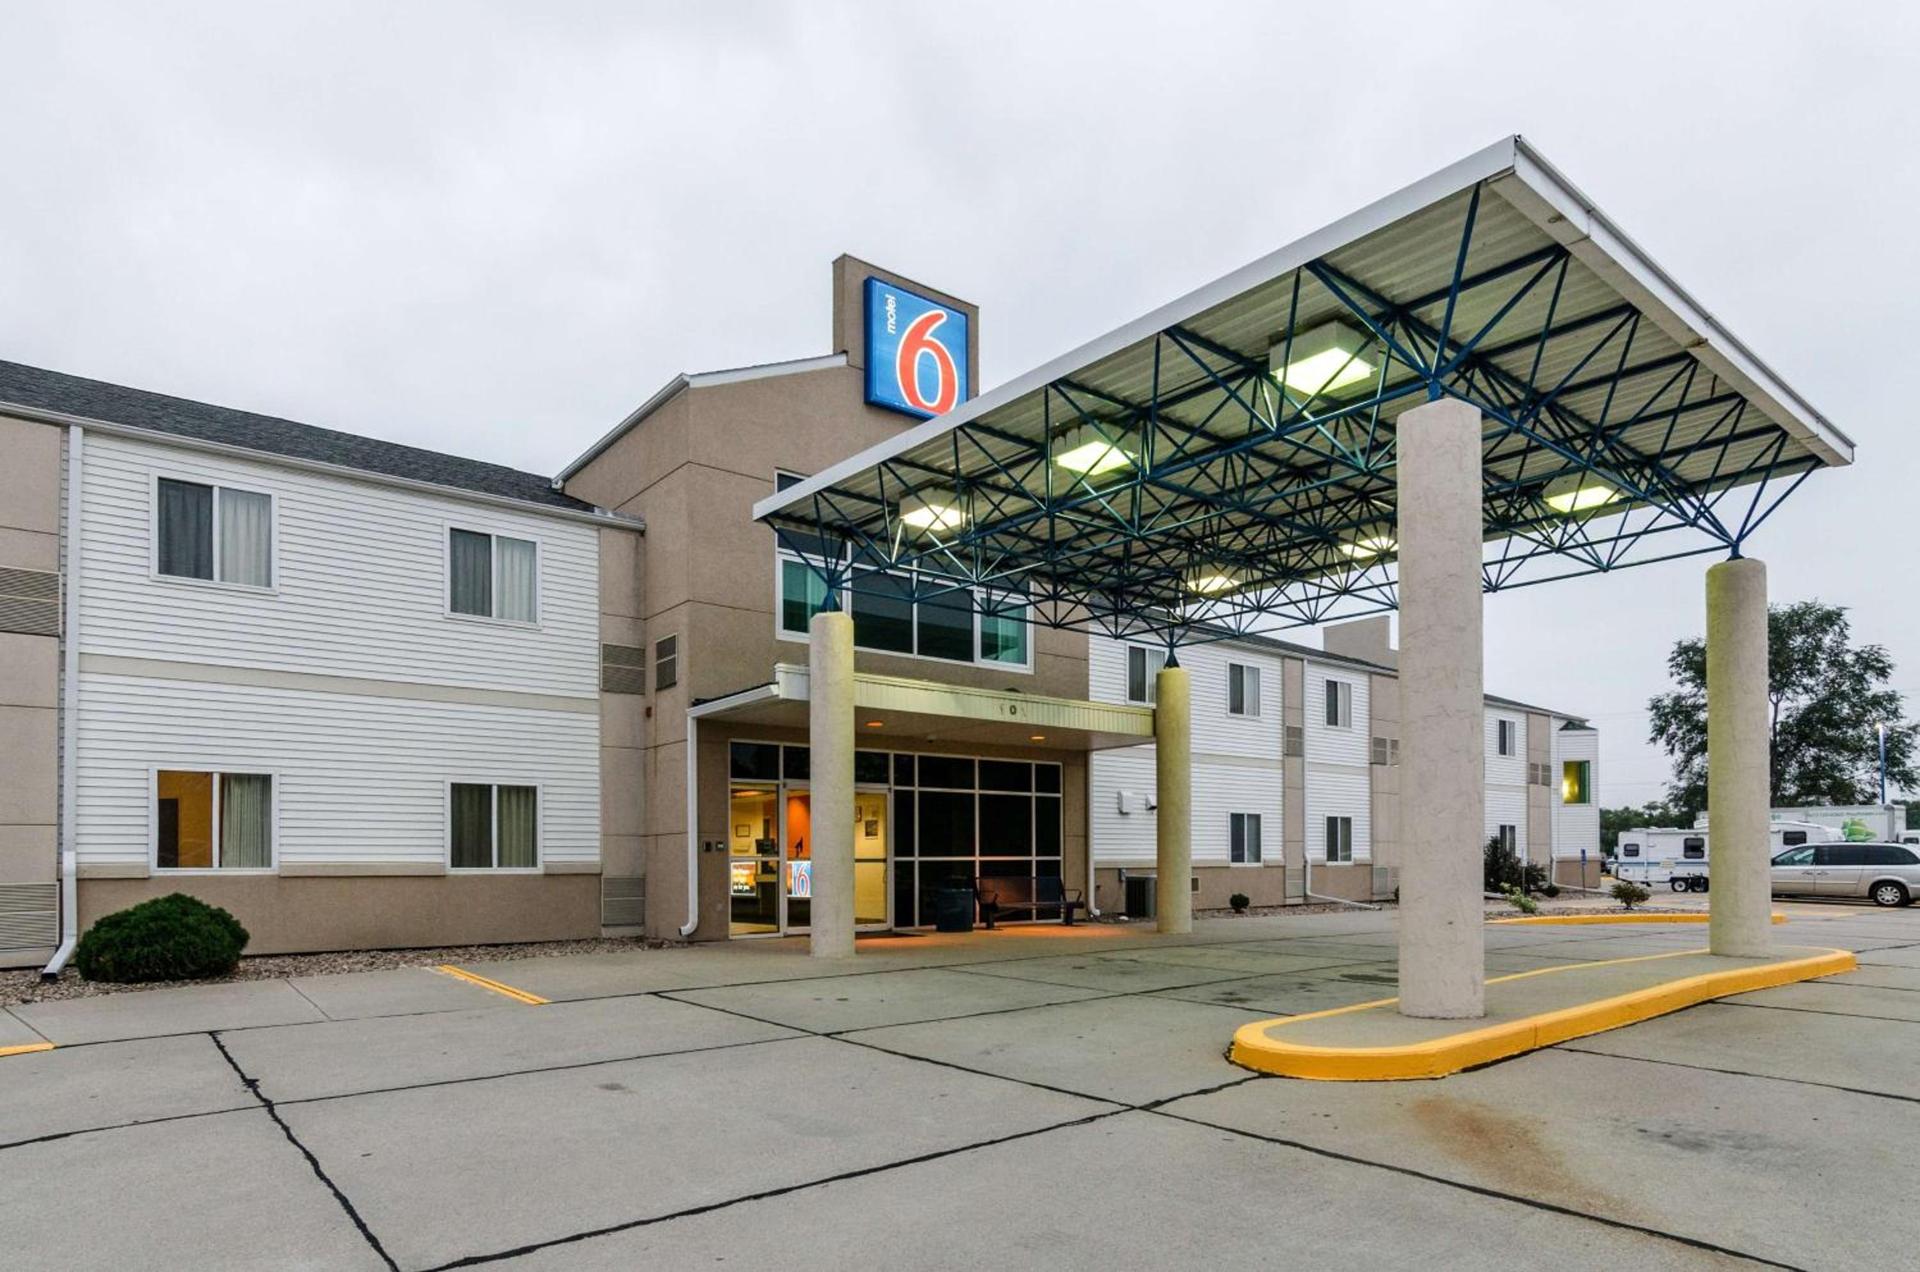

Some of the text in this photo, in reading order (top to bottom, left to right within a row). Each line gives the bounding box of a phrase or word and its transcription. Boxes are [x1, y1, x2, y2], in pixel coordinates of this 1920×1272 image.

[885, 294, 896, 334] motel
[896, 310, 958, 416] 6
[796, 862, 810, 897] 6
